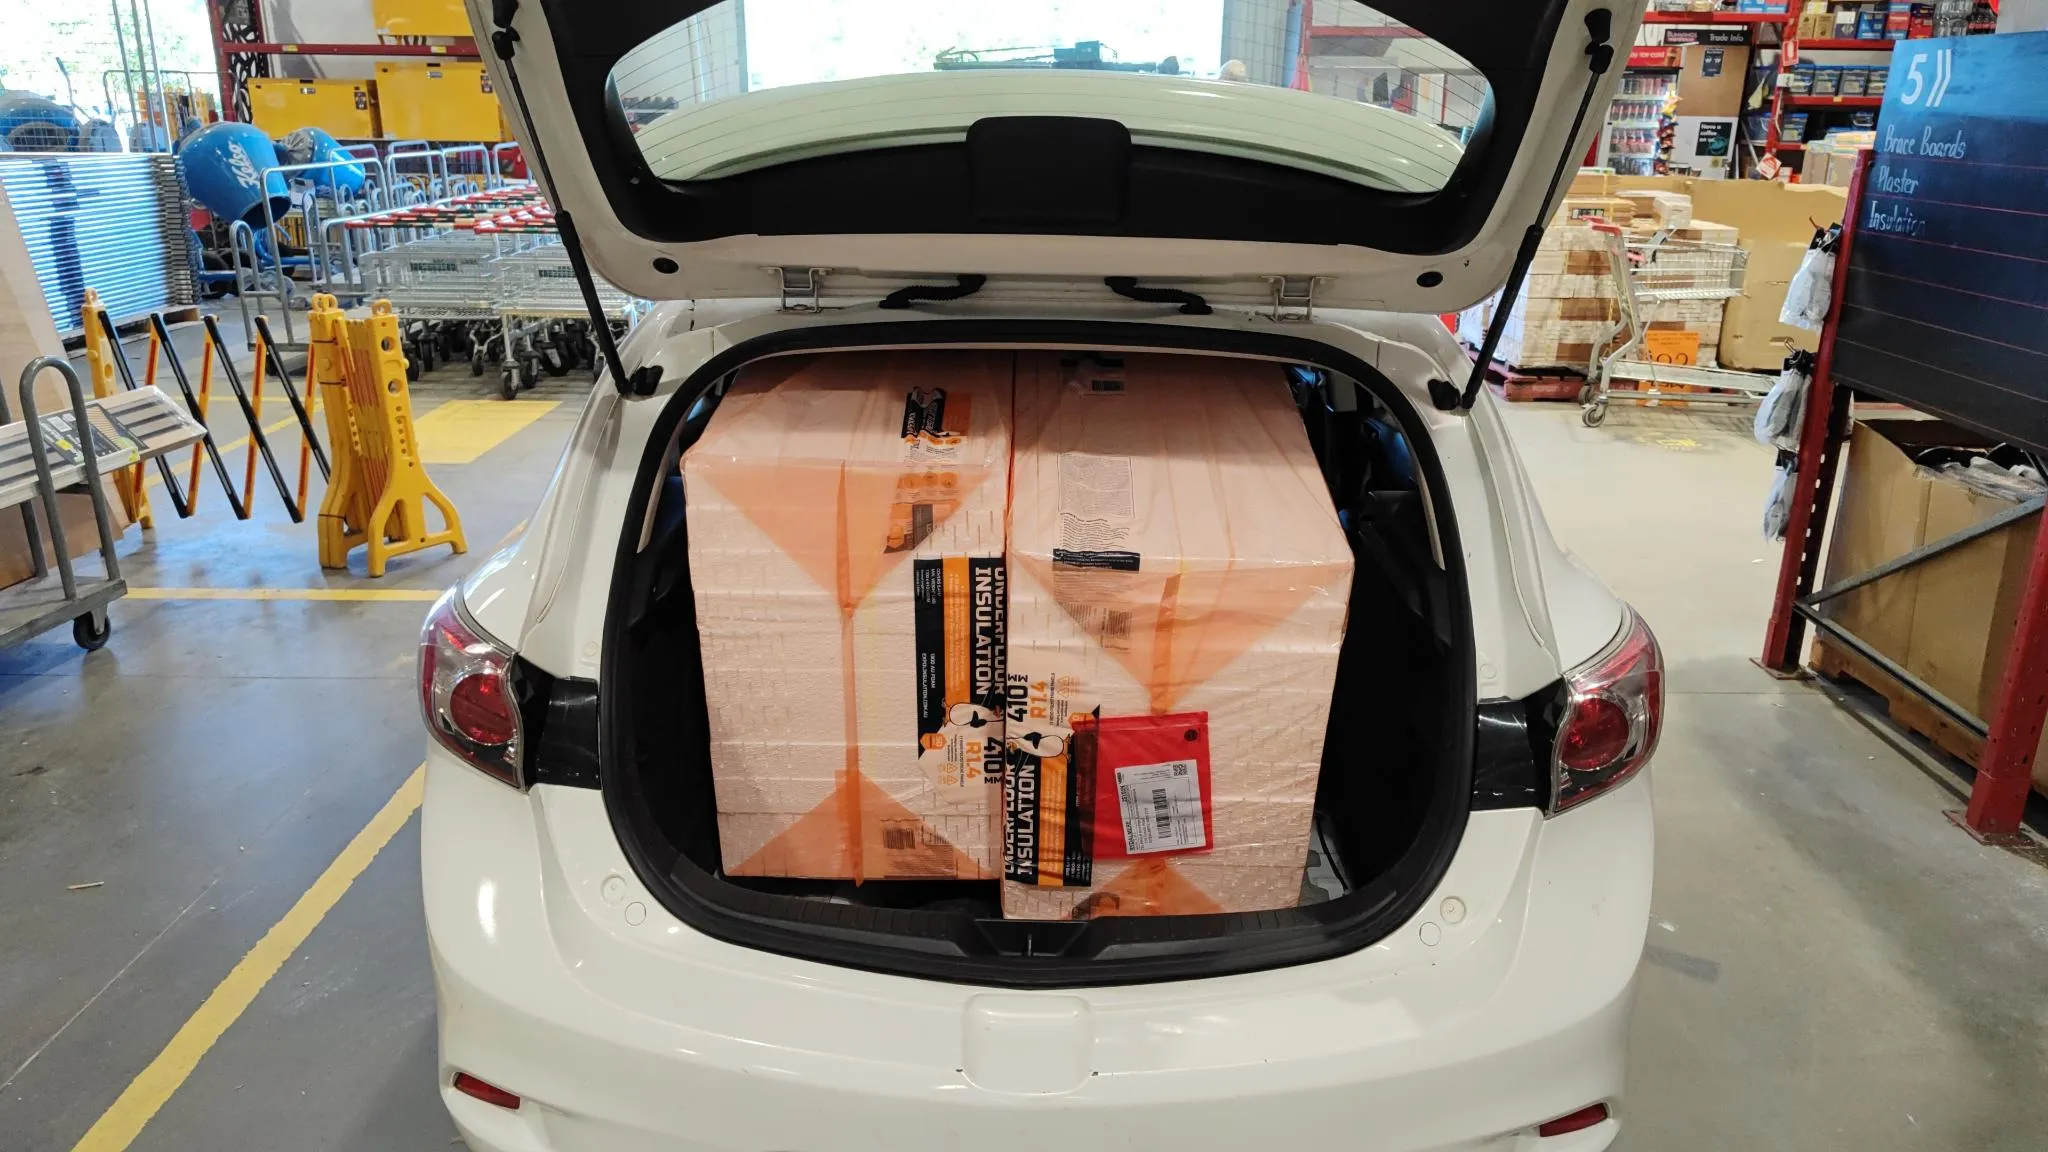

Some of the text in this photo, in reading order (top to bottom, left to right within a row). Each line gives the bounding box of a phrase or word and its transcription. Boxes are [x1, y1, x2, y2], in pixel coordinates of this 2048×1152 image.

[1709, 33, 1744, 42] Trade Info
[1900, 53, 1928, 106] 5
[1883, 124, 1966, 159] Brace Boards
[228, 137, 260, 189] Kelso
[1877, 165, 1919, 195] Plaster
[975, 566, 992, 695] INSULATION
[1007, 673, 1028, 683] MM
[1007, 685, 1028, 723] 410
[1029, 680, 1048, 719] R1.4
[966, 741, 982, 779] R1.4
[984, 736, 1005, 774] 410
[984, 776, 1005, 785] MM
[1017, 764, 1035, 875] INSULATION
